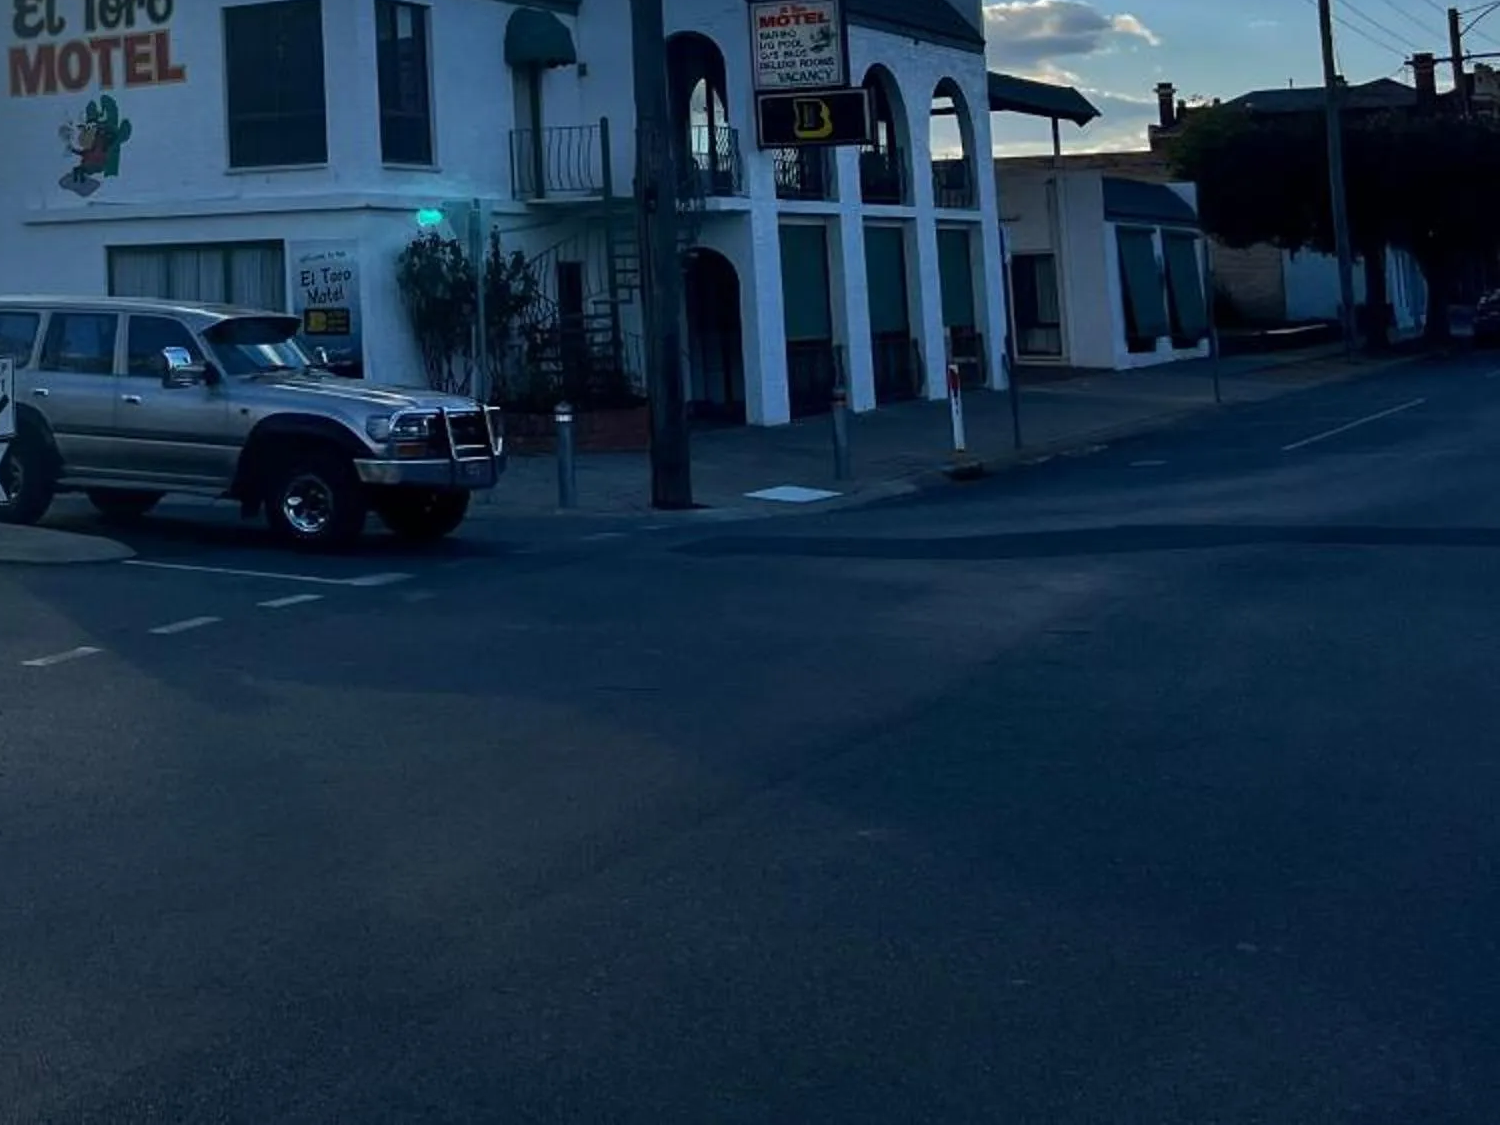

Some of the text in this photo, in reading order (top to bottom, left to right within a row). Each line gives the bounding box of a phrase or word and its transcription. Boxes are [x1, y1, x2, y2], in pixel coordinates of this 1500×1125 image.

[759, 10, 831, 28] MOTEL
[8, 28, 187, 97] MOTEL
[799, 56, 835, 68] ROOMS
[777, 68, 835, 82] VACANCY
